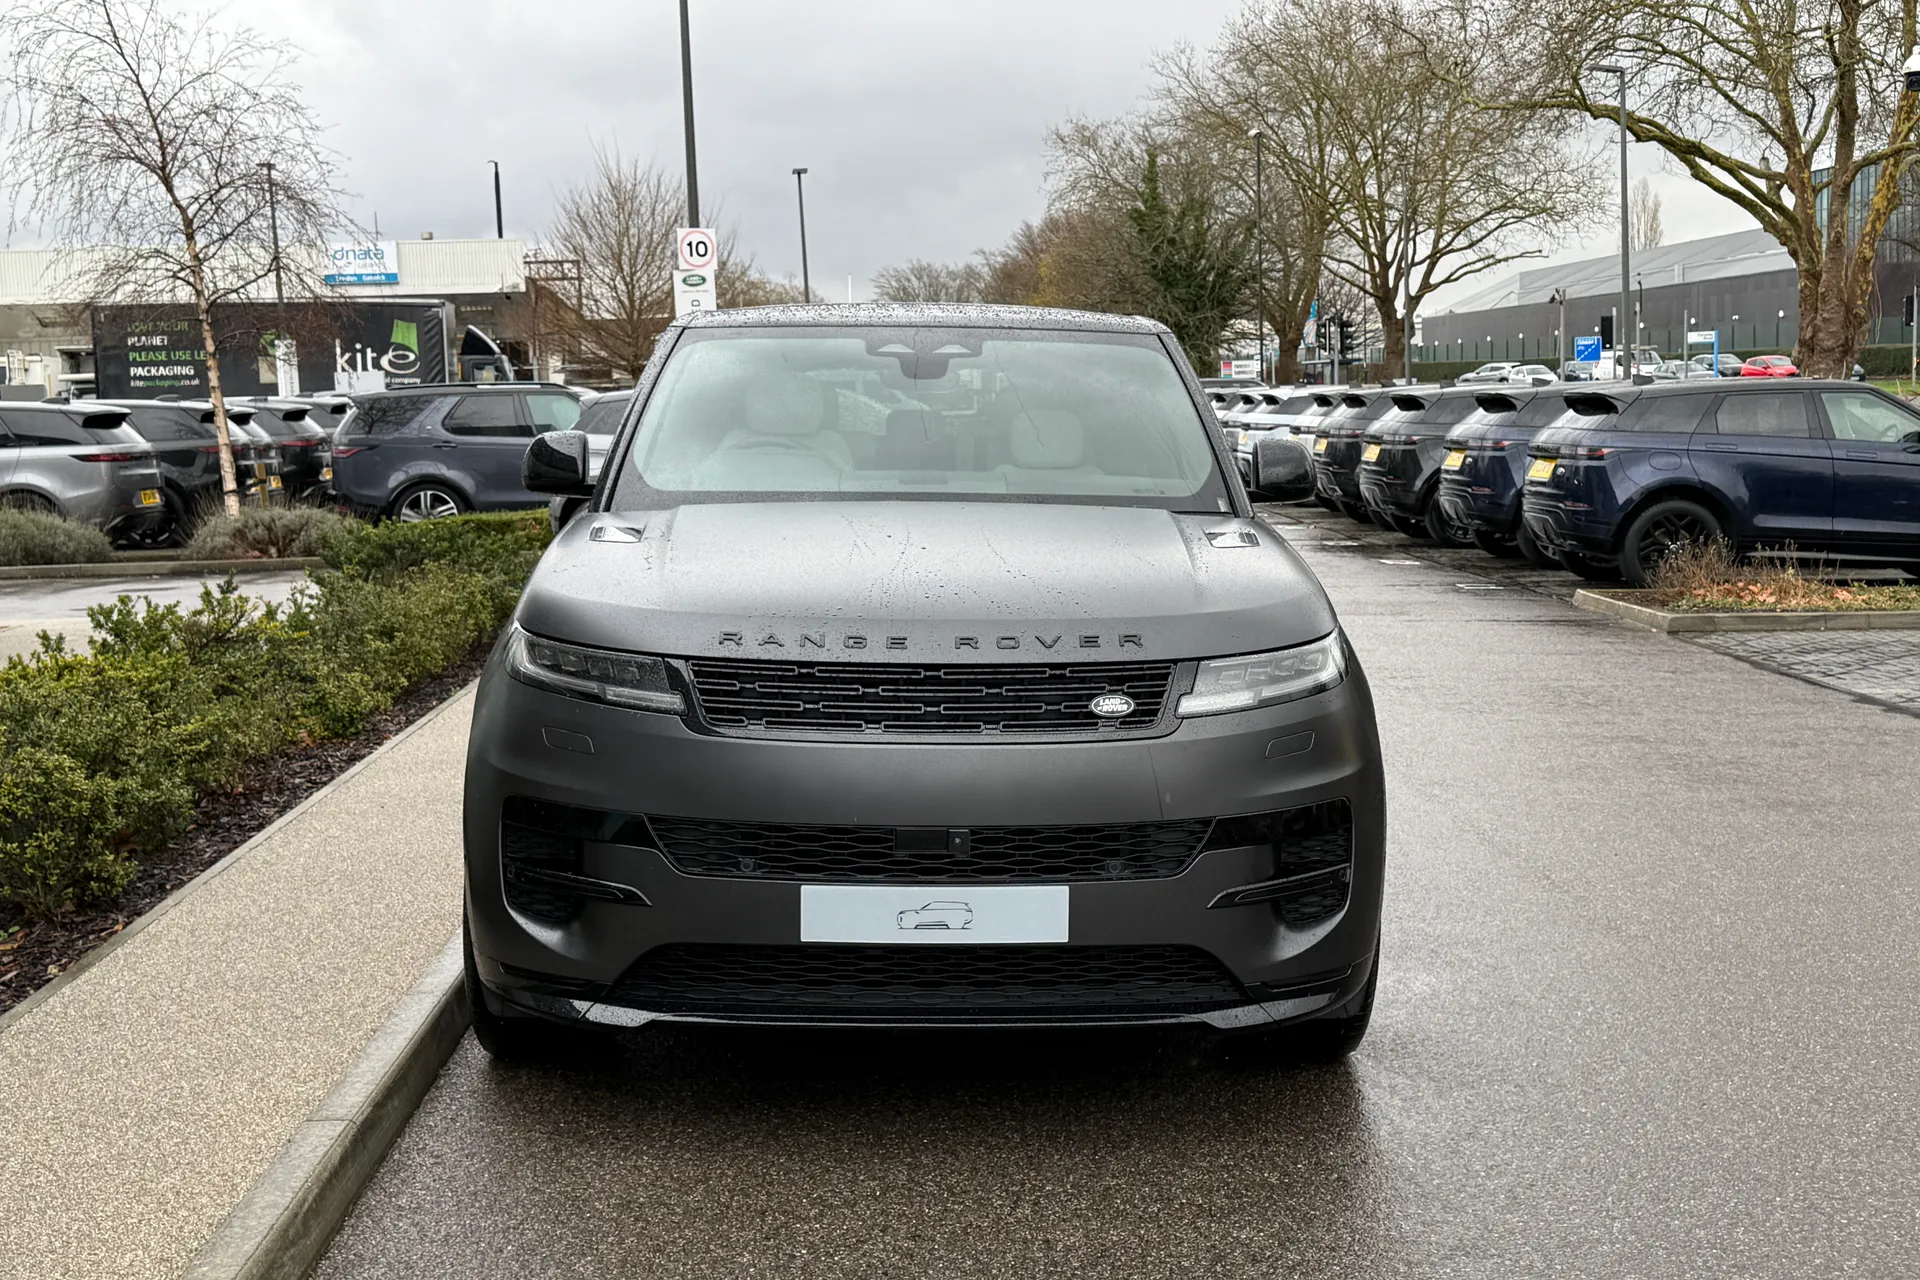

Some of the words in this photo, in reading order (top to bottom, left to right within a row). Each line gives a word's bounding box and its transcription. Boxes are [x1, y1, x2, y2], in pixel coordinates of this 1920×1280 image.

[332, 247, 385, 260] dnata
[687, 241, 708, 257] 10
[127, 335, 168, 347] PLANET
[129, 351, 168, 362] PLEASE
[171, 350, 192, 361] USE
[194, 350, 208, 361] LE
[335, 338, 421, 375] kite
[130, 365, 195, 377] PACKAGING
[130, 378, 200, 388] kitepackaging.co.uk
[718, 631, 908, 650] RANGE
[954, 634, 1144, 650] ROVER
[1099, 698, 1121, 706] LAND
[1101, 704, 1128, 712] ROVER
